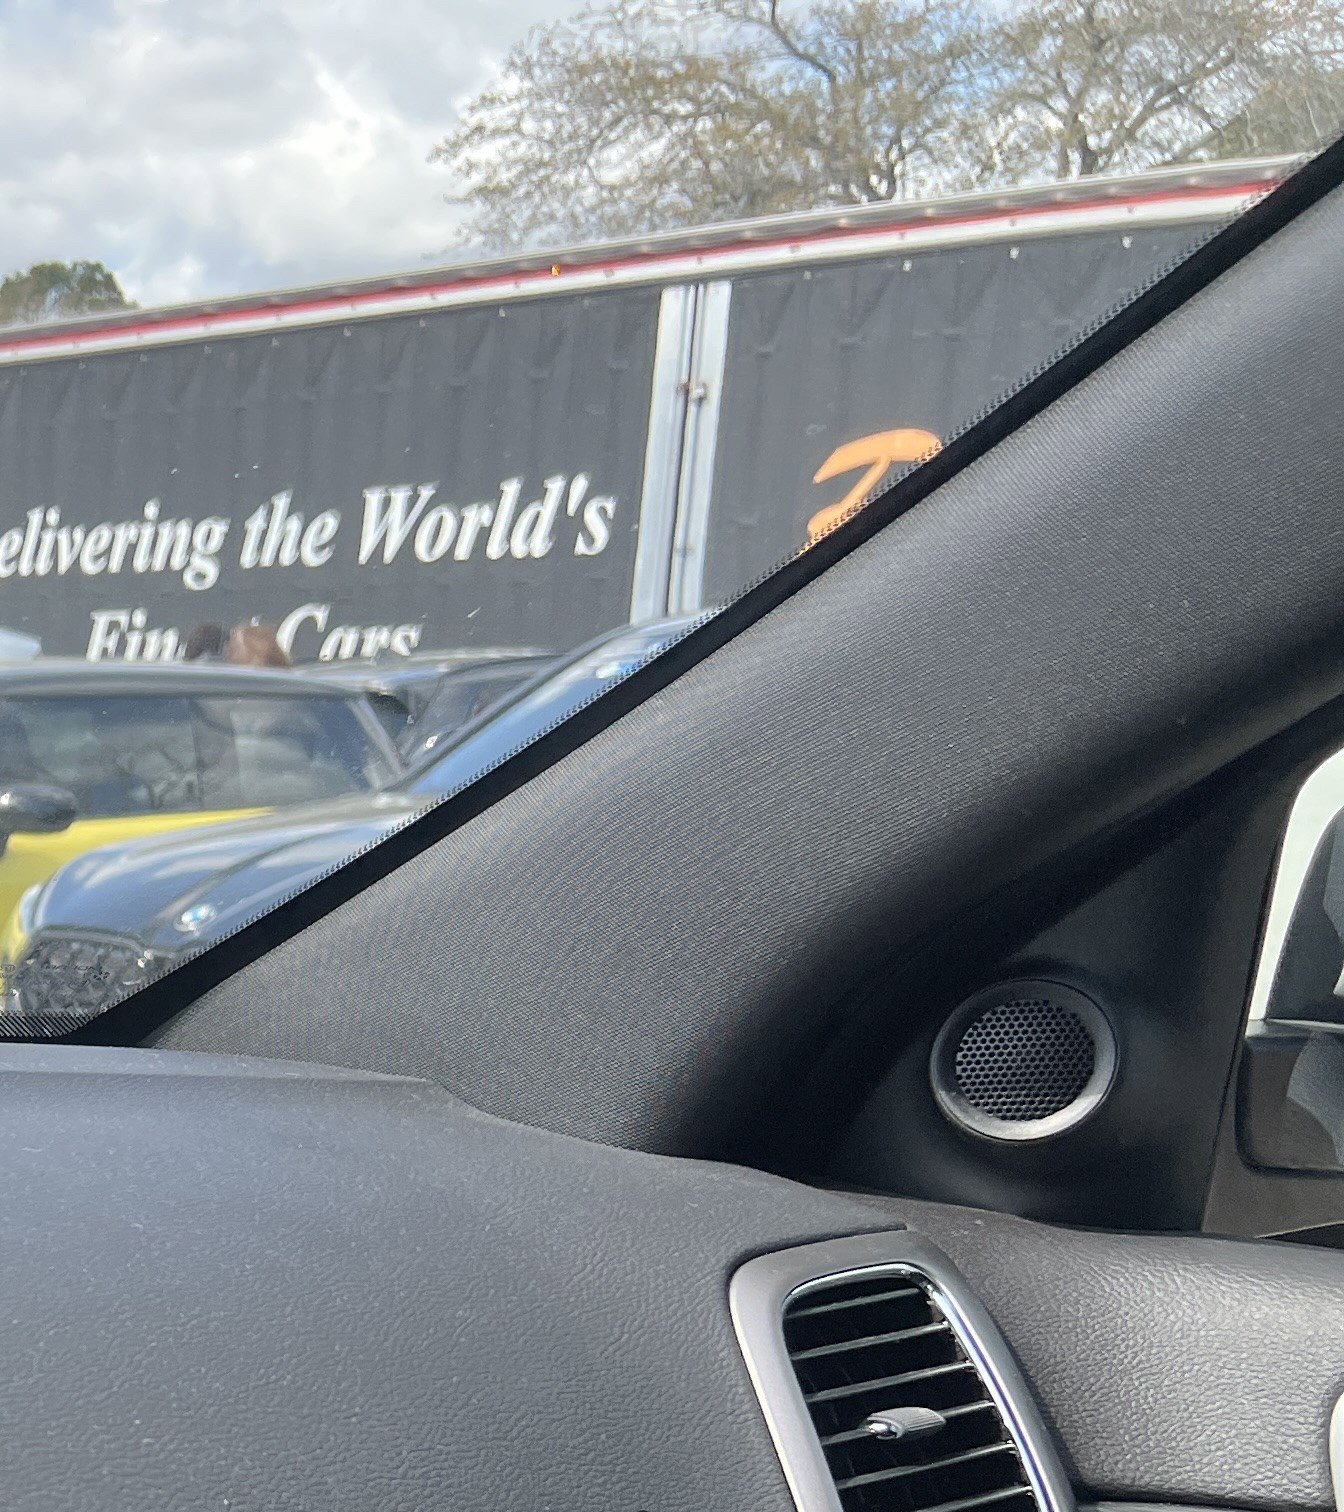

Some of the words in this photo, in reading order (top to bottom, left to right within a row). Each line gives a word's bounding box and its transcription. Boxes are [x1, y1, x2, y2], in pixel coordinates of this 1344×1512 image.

[239, 488, 341, 569] the
[358, 473, 617, 566] World's
[85, 606, 192, 664] Fin
[275, 602, 424, 664] Cars
